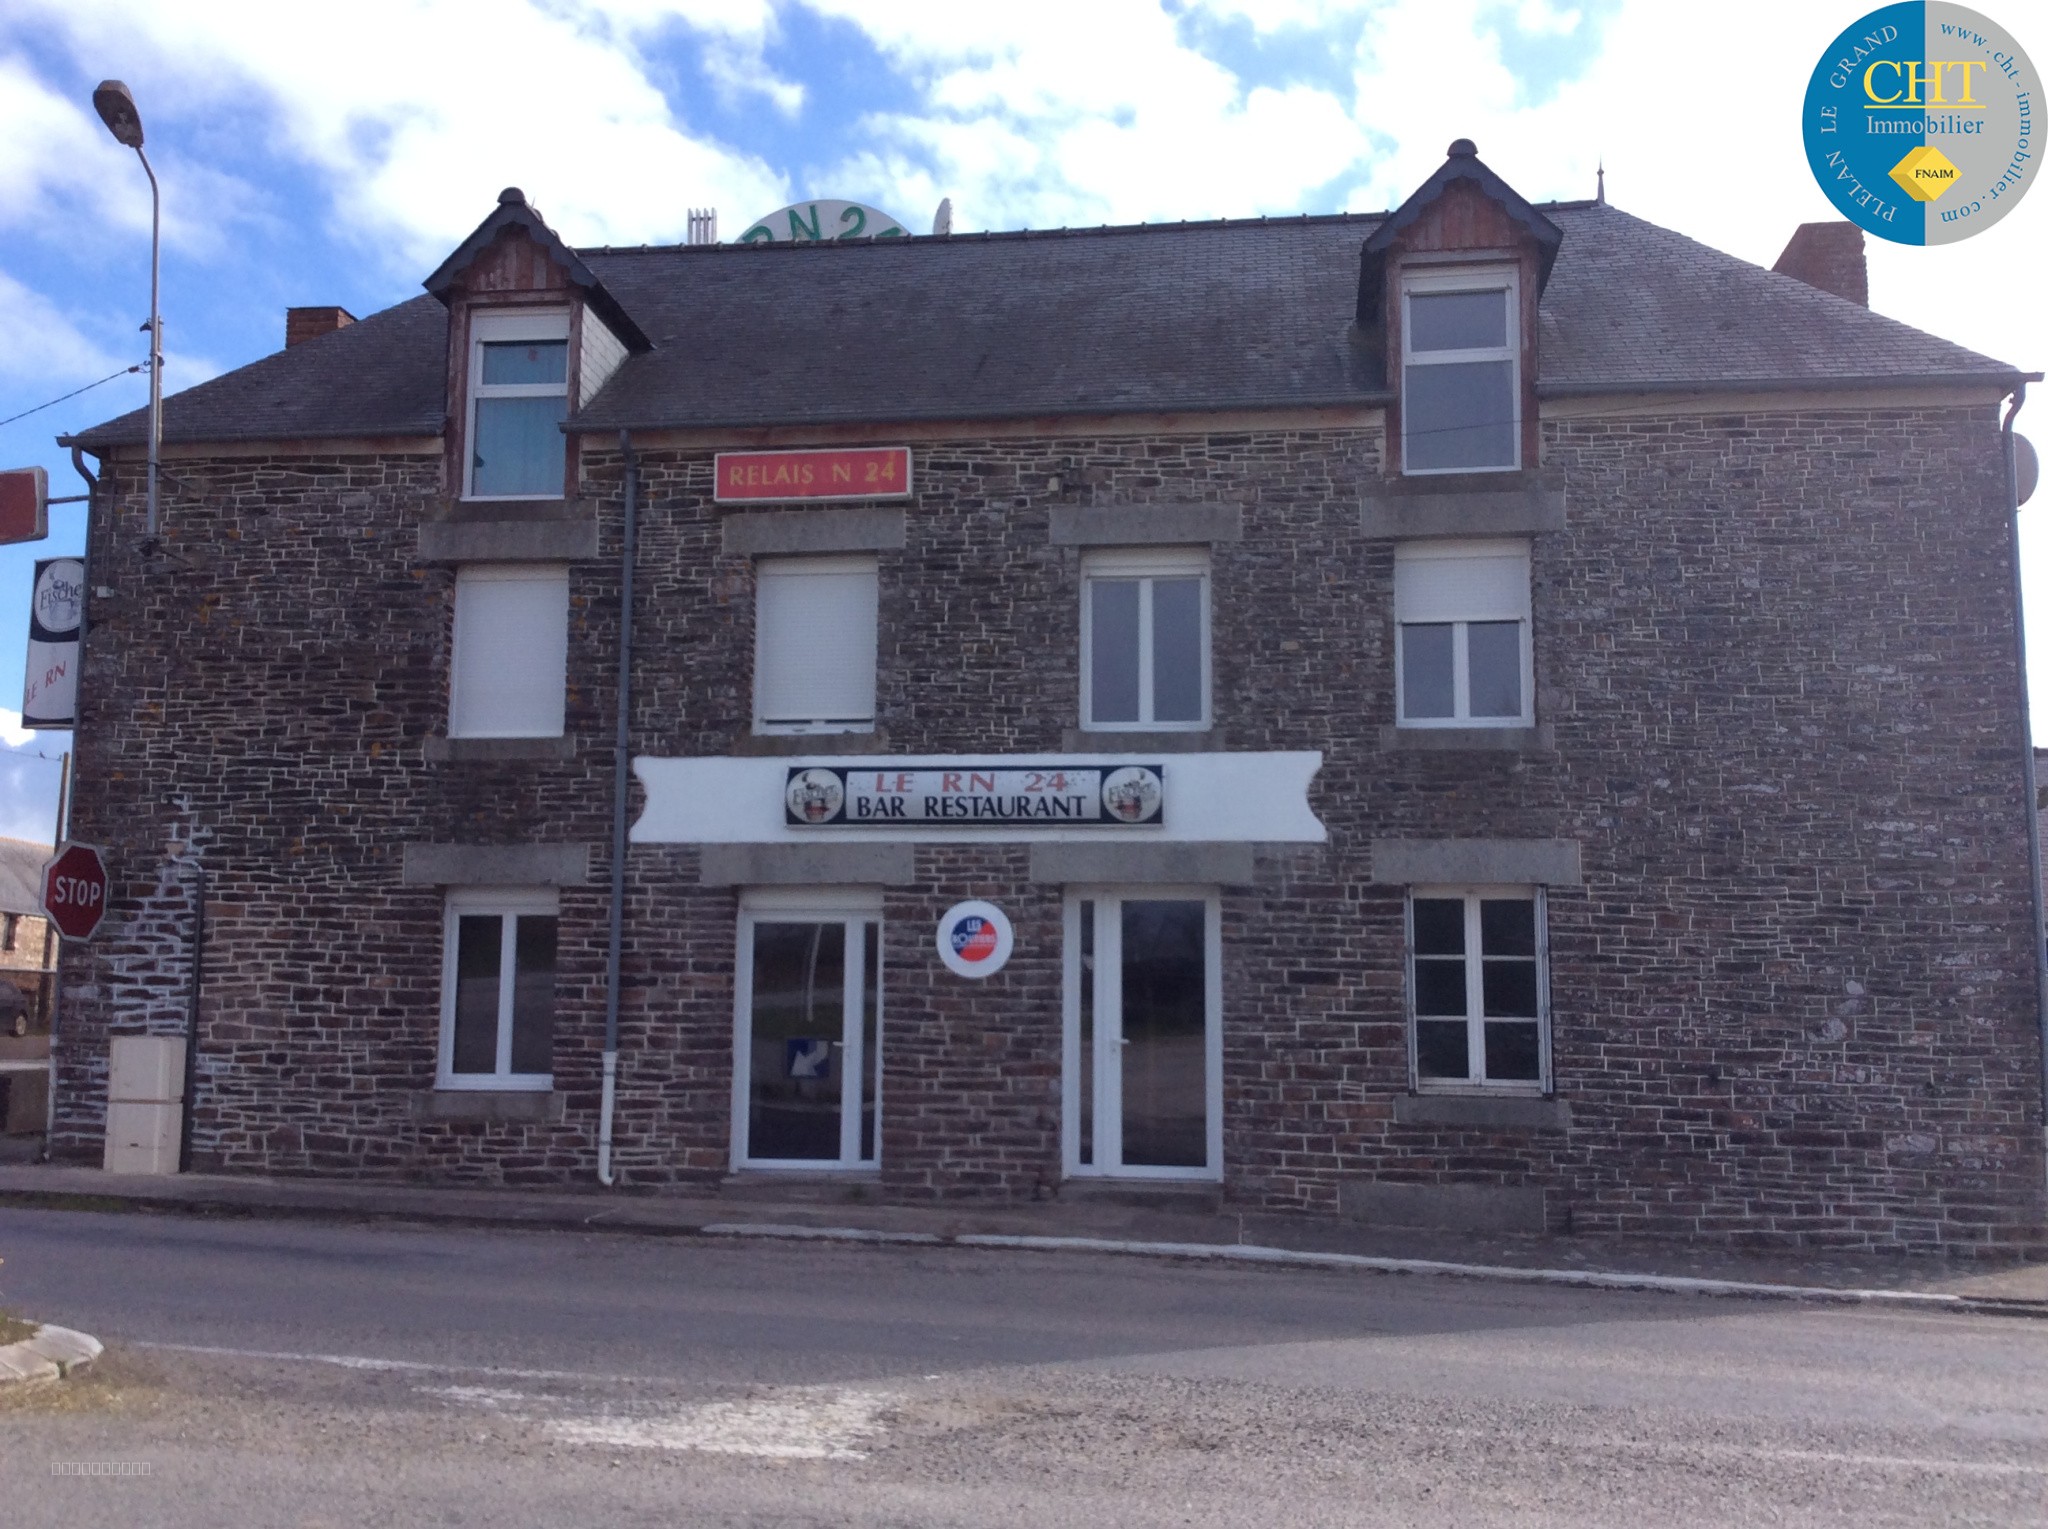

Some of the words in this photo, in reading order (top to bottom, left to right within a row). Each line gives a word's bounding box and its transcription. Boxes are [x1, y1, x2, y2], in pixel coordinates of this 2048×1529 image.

[730, 463, 814, 486] RELAIS
[832, 463, 851, 482] N
[865, 460, 896, 482] 24
[45, 660, 67, 688] RN
[875, 773, 914, 793] LE
[942, 772, 996, 793] RN
[1024, 772, 1068, 792] 24
[857, 796, 908, 818] BAR
[924, 795, 1088, 818] RESTAURANT
[54, 875, 101, 907] STOP
